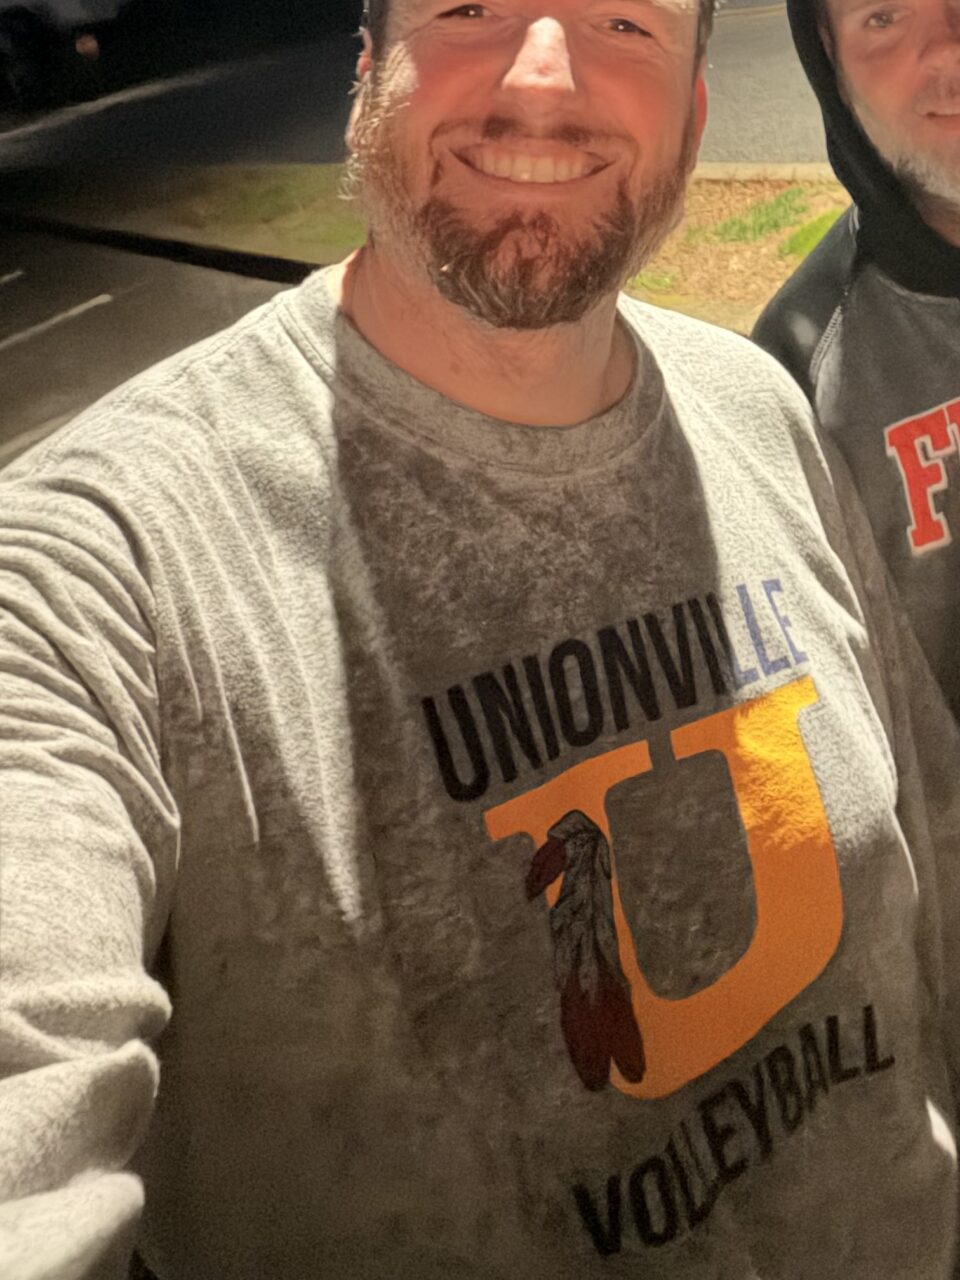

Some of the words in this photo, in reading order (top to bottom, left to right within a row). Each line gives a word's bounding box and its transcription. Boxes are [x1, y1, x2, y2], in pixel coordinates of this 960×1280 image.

[421, 579, 809, 802] UNIONVILLE
[483, 674, 843, 1101] U
[572, 1004, 895, 1256] VOLLEYBALL
